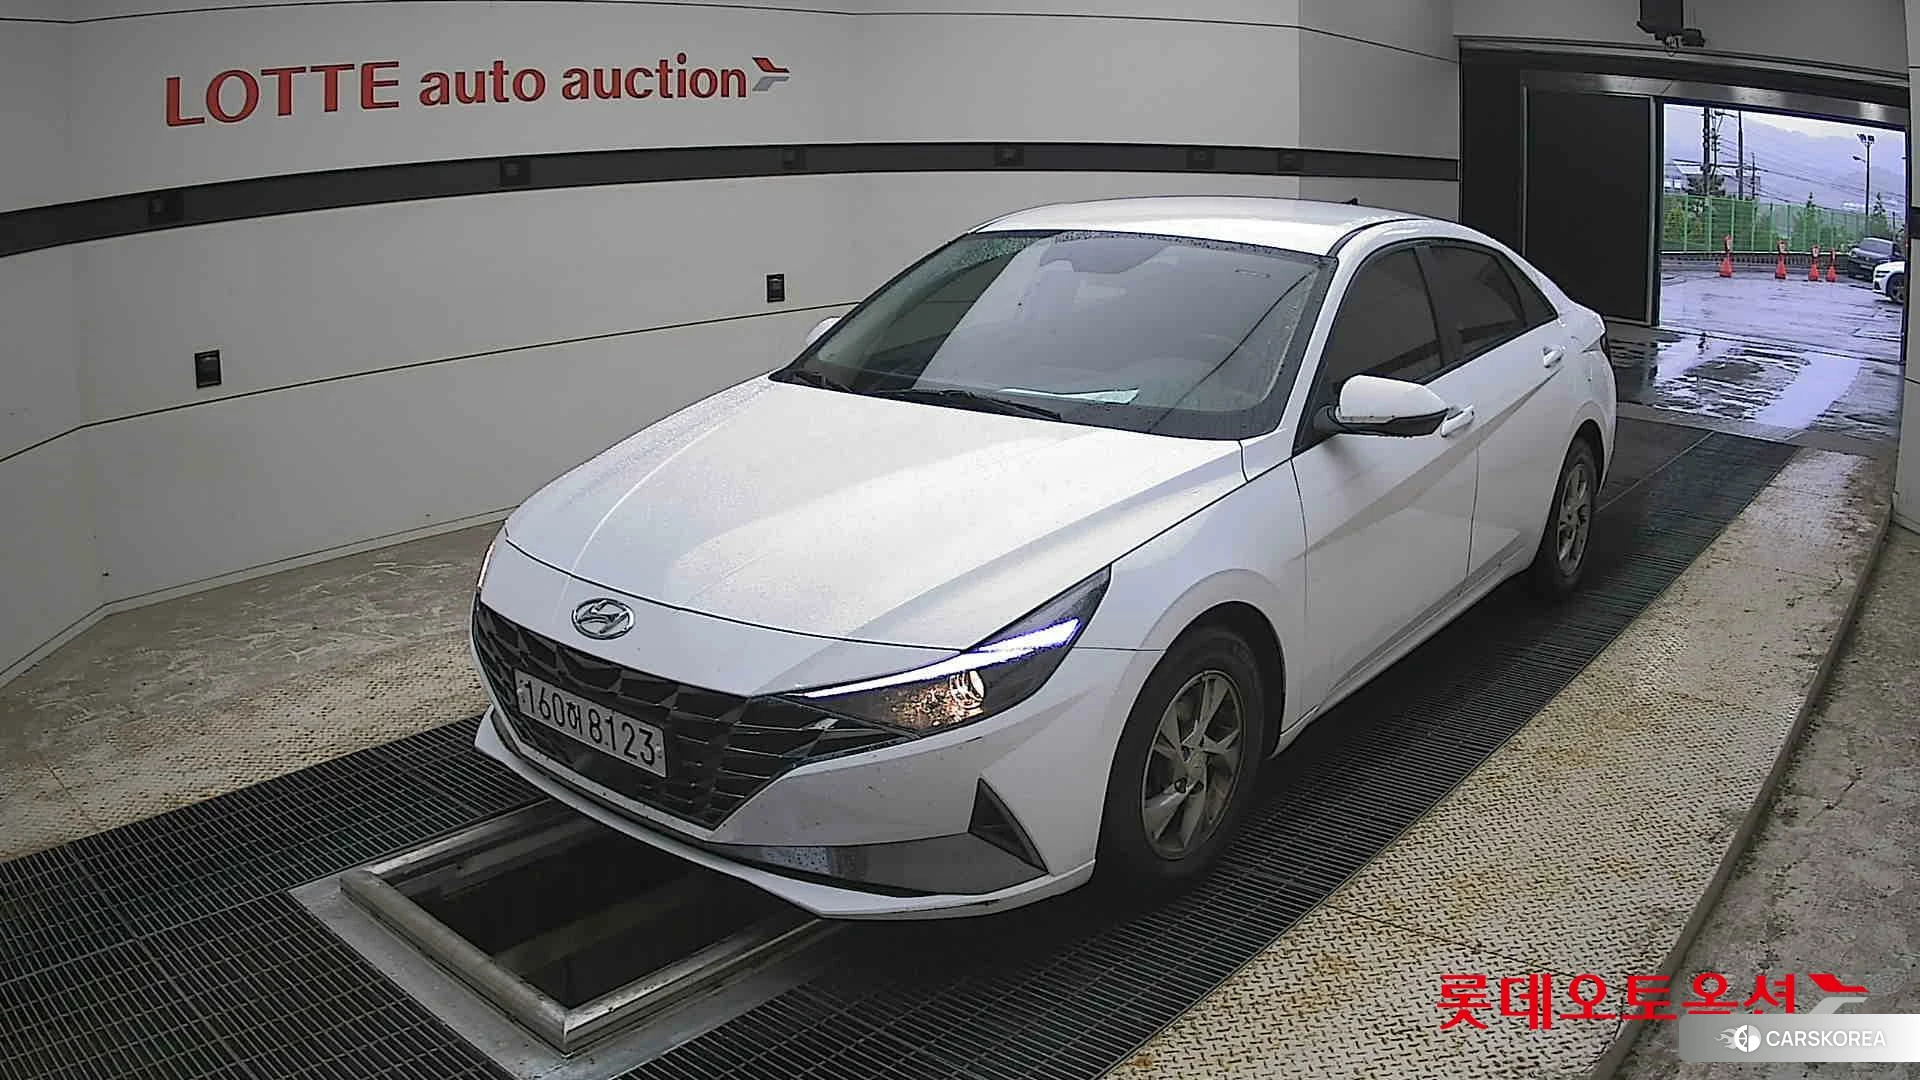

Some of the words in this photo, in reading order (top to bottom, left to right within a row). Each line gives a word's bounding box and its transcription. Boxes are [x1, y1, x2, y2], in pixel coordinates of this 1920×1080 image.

[165, 60, 401, 127] LOTTE
[418, 60, 546, 107] auto
[561, 52, 748, 100] auction
